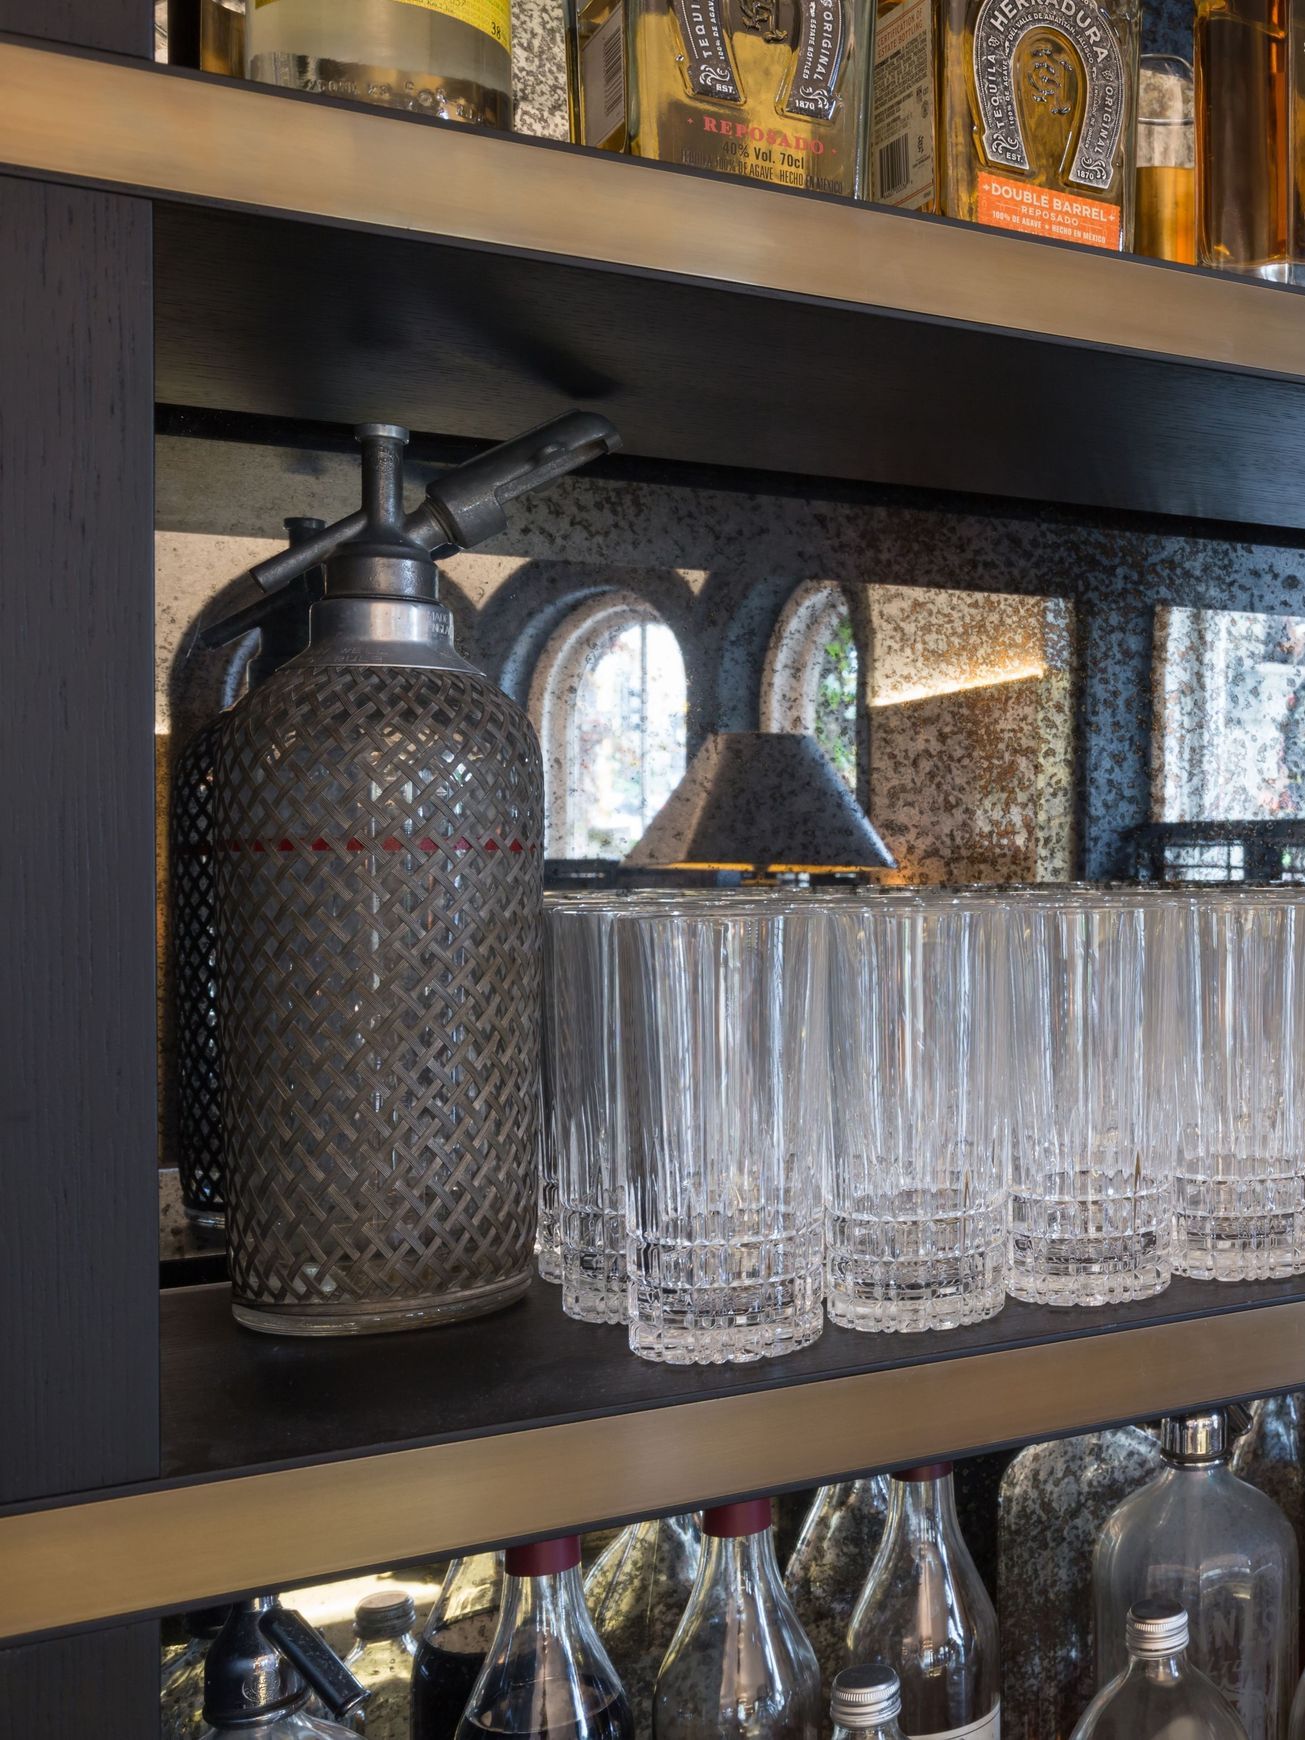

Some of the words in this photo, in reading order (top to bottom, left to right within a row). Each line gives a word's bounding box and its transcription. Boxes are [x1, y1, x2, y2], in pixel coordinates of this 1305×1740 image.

[808, 18, 817, 45] ESTATE
[1008, 27, 1018, 41] DEL
[1016, 15, 1033, 28] VALLE
[1034, 12, 1044, 20] DE
[813, 12, 833, 81] ORIGINAL
[803, 46, 816, 80] BOTTLED
[1002, 60, 1010, 87] AGAVE
[716, 84, 736, 95] EST.
[987, 53, 1006, 129] TEQUILA
[1005, 92, 1011, 102] DE
[795, 99, 815, 110] 1870
[1094, 85, 1114, 154] ORIGINAL
[703, 115, 824, 155] REPOSADO
[723, 141, 750, 159] 40%
[754, 146, 776, 164] Vol.
[780, 152, 804, 170] 70cl
[1006, 153, 1023, 163] EST.
[738, 161, 747, 175] DE
[750, 163, 774, 180] AGAVE
[779, 170, 804, 187] HECHO
[1076, 169, 1094, 180] 1870
[991, 182, 1049, 208] DOUBLE
[1053, 198, 1107, 222] BARREL
[992, 210, 1011, 222] 100%
[1012, 214, 1020, 224] DE
[1022, 217, 1042, 229] AGAVE
[1051, 225, 1072, 237] HECHO
[1073, 228, 1081, 239] EN
[1021, 206, 1079, 227] REPOSADO
